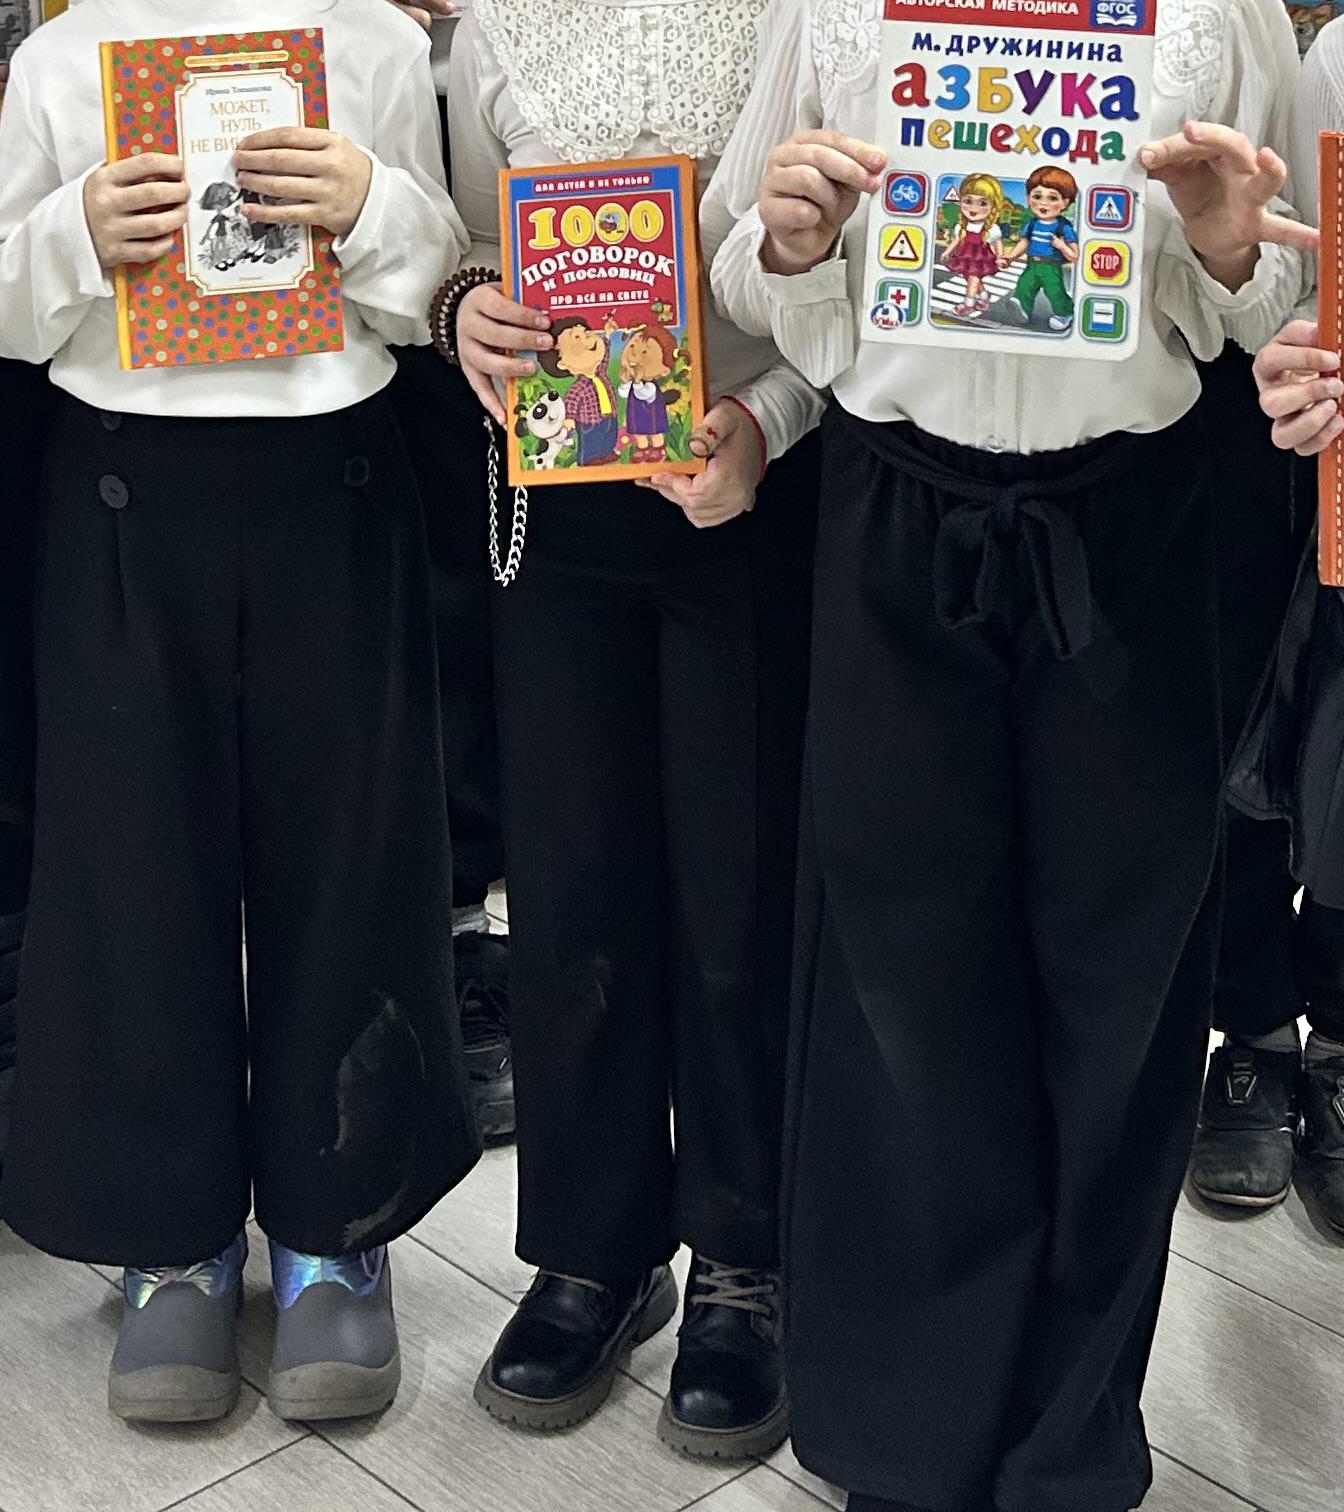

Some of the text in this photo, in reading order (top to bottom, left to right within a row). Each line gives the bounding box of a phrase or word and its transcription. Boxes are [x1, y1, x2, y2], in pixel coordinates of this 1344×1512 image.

[1096, 0, 1136, 16] ФГОС
[221, 118, 262, 133] НУЛЬ
[191, 139, 211, 153] НЕ
[528, 200, 665, 250] 1000
[521, 245, 675, 287] ПОГОВОРОК
[1092, 253, 1119, 271] STOP
[542, 266, 656, 292] И ПОСЛОВИЦ
